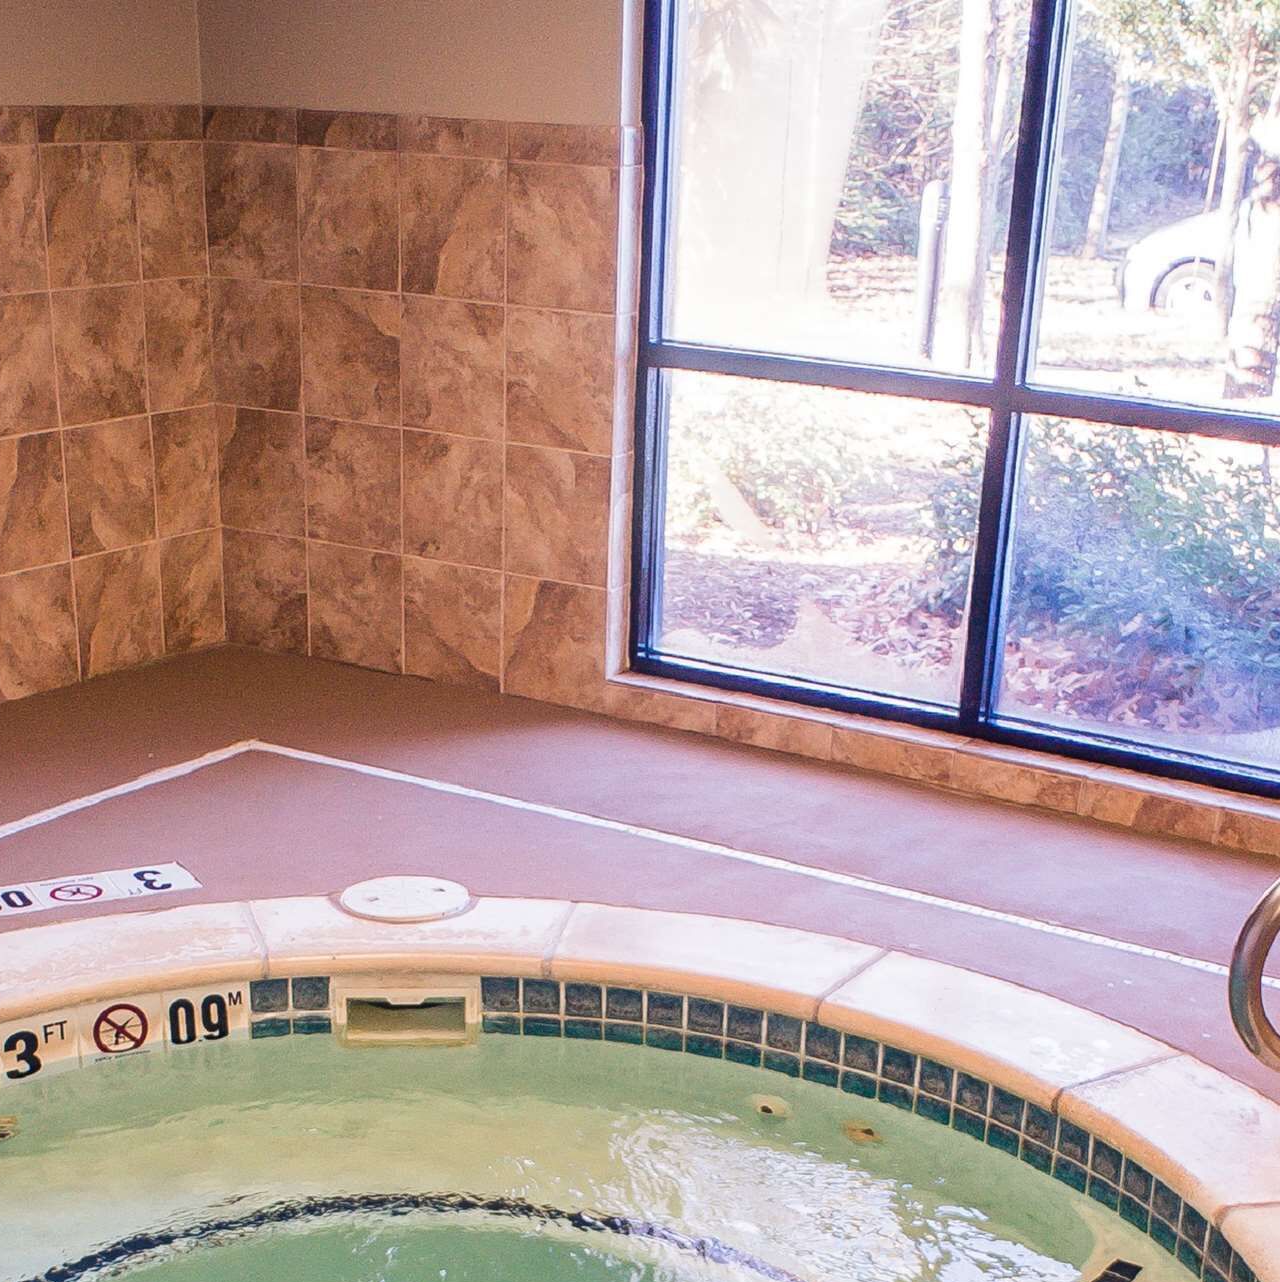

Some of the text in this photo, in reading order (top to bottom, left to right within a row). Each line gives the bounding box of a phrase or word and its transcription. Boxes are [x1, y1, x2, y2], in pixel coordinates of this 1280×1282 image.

[133, 870, 172, 891] 3
[228, 991, 242, 1006] M
[4, 1020, 68, 1080] 3 FT
